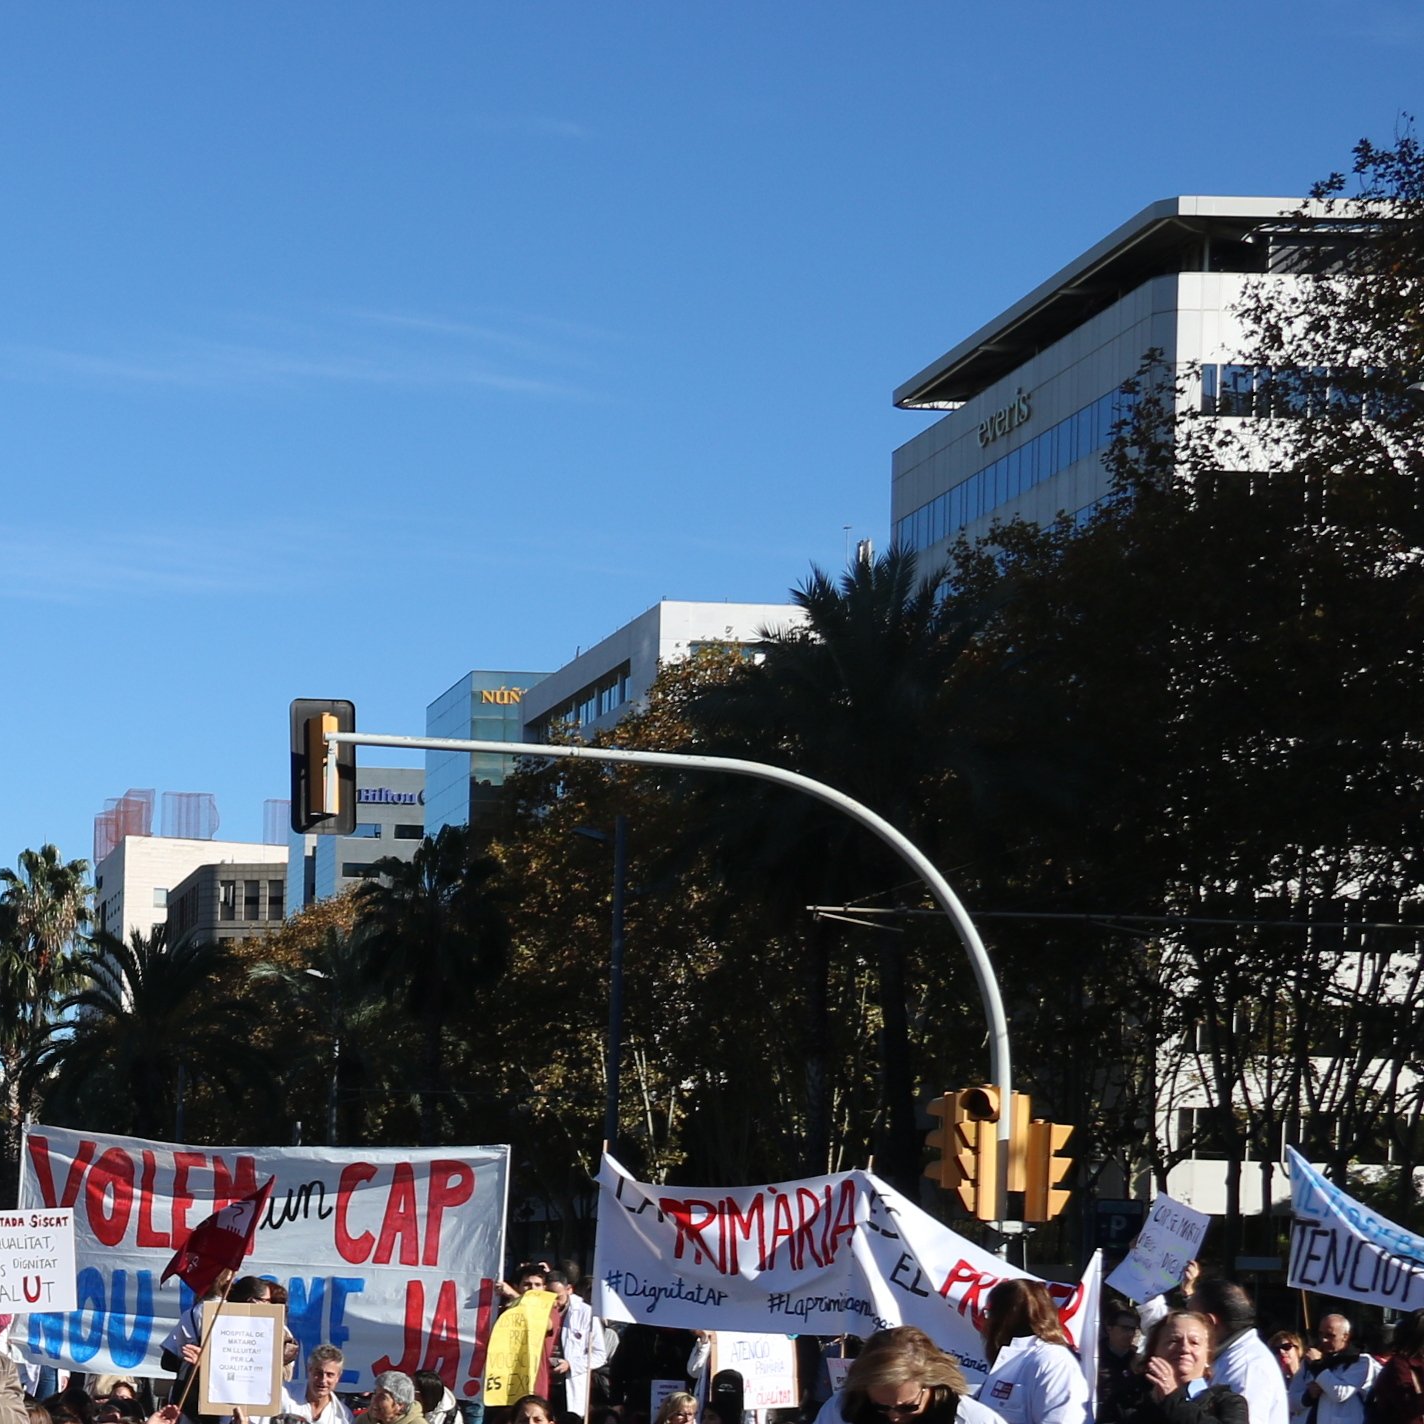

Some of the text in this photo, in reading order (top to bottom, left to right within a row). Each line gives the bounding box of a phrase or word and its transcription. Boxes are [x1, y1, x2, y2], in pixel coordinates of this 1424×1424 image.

[977, 387, 1031, 448] everis
[481, 686, 527, 705] NÚÑ
[356, 788, 417, 805] Hilton
[260, 1180, 333, 1230] un
[334, 1159, 475, 1267] CAP
[659, 1179, 856, 1276] PRIMÀRIA
[889, 1252, 929, 1298] EL
[486, 1373, 502, 1391] ÉS
